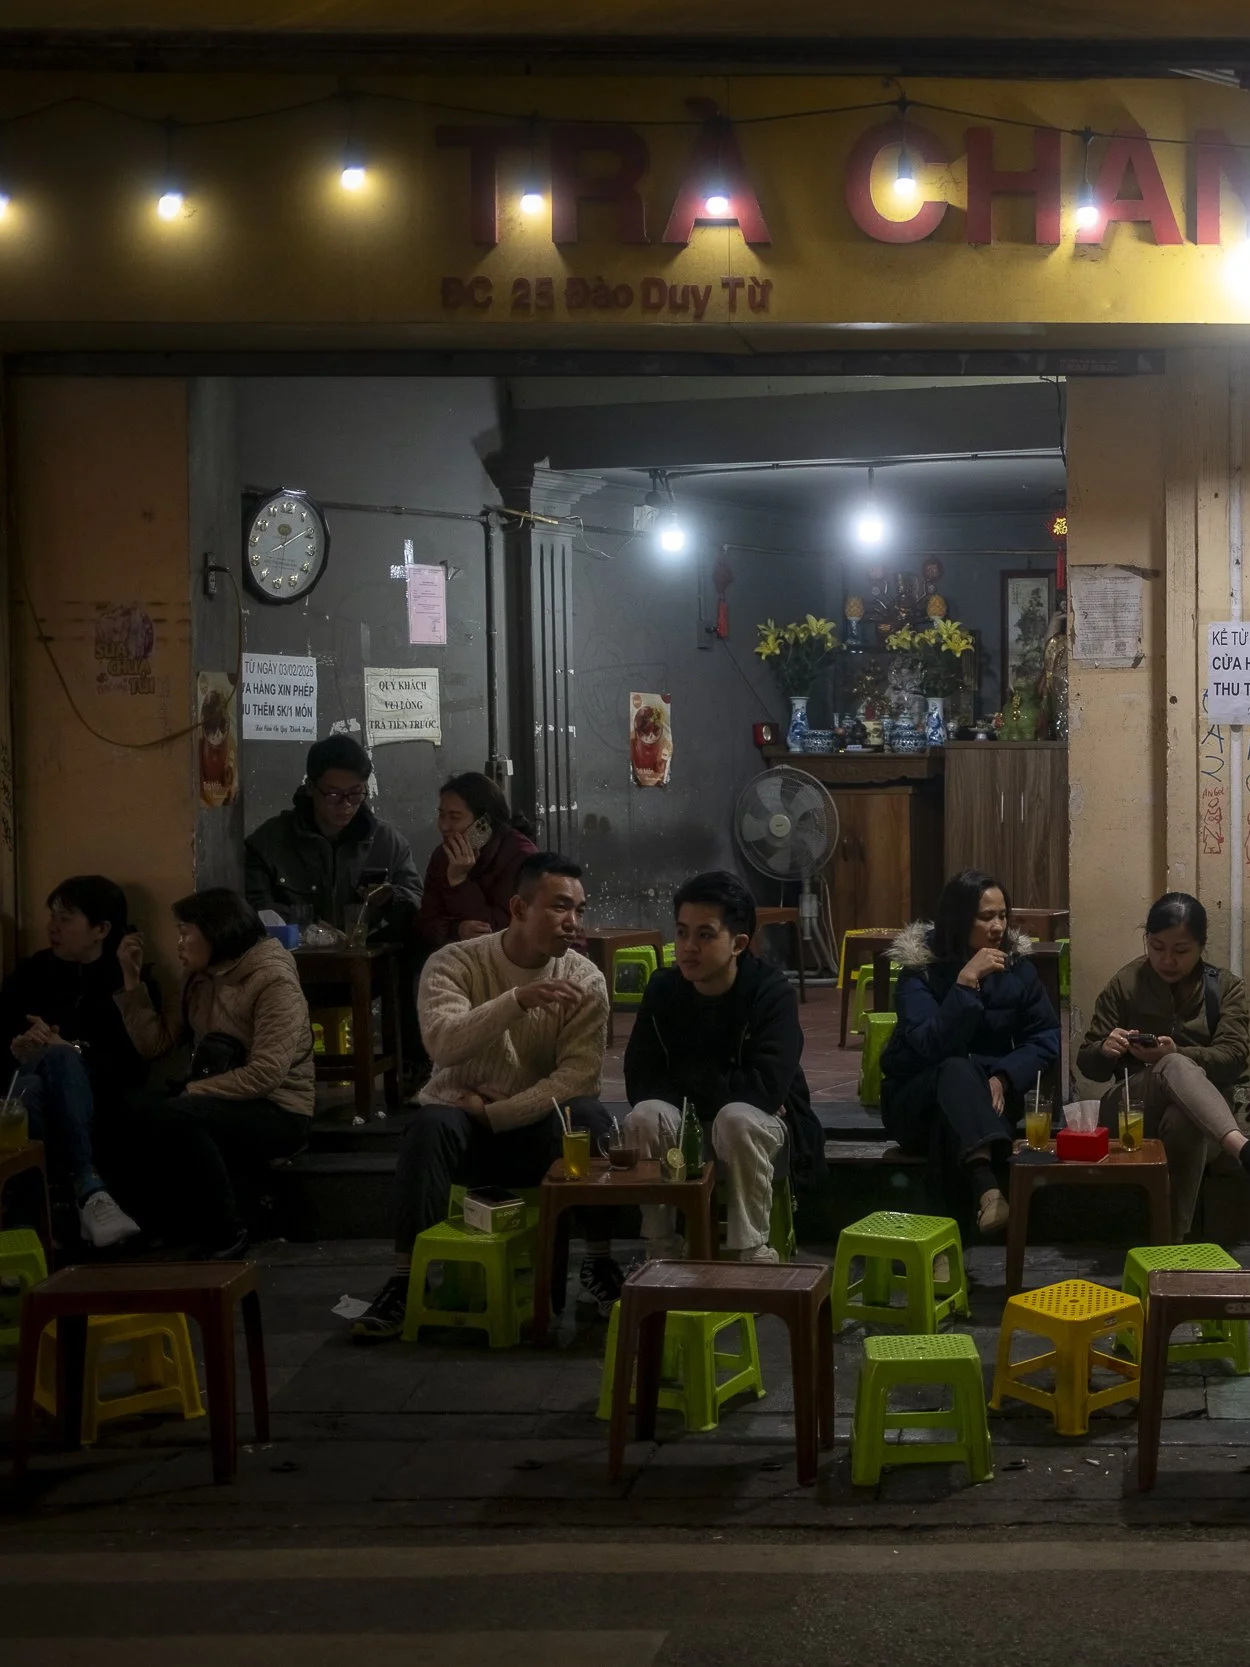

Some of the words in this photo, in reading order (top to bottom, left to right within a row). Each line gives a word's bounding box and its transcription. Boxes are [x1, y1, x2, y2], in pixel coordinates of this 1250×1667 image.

[435, 97, 771, 244] TRÀ
[511, 277, 555, 309] 25
[640, 277, 711, 319] Duy
[281, 501, 296, 514] 12
[1231, 628, 1249, 646] TỪ
[257, 660, 277, 675] NGÀY
[253, 680, 276, 696] HÀNG
[278, 683, 291, 696] XIN
[293, 682, 315, 697] PHÉP
[398, 679, 427, 691] KHÁCH
[1213, 682, 1240, 696] THU
[252, 702, 275, 717] THÊM
[276, 705, 293, 718] 5K/1
[295, 703, 313, 718] MÓN
